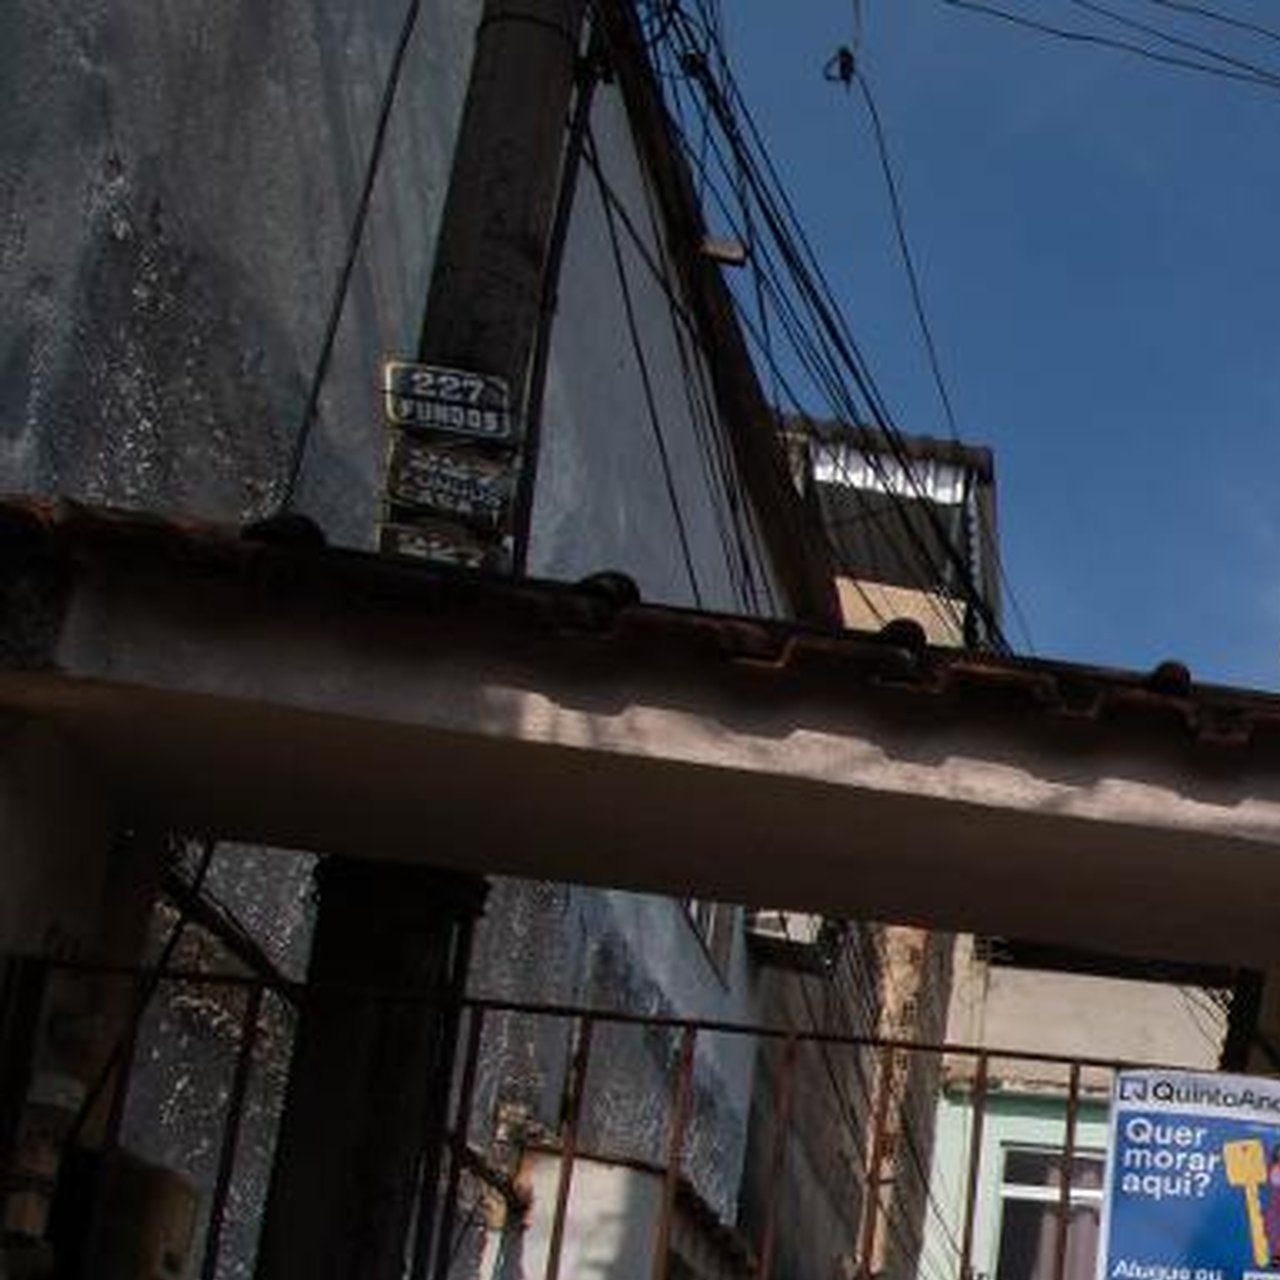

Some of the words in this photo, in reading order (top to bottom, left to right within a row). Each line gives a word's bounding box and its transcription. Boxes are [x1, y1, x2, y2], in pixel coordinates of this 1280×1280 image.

[410, 371, 485, 403] 227
[400, 400, 498, 432] FUNDOS
[1126, 1117, 1208, 1146] Quer
[1123, 1147, 1220, 1172] morar
[1121, 1172, 1212, 1200] aqui?
